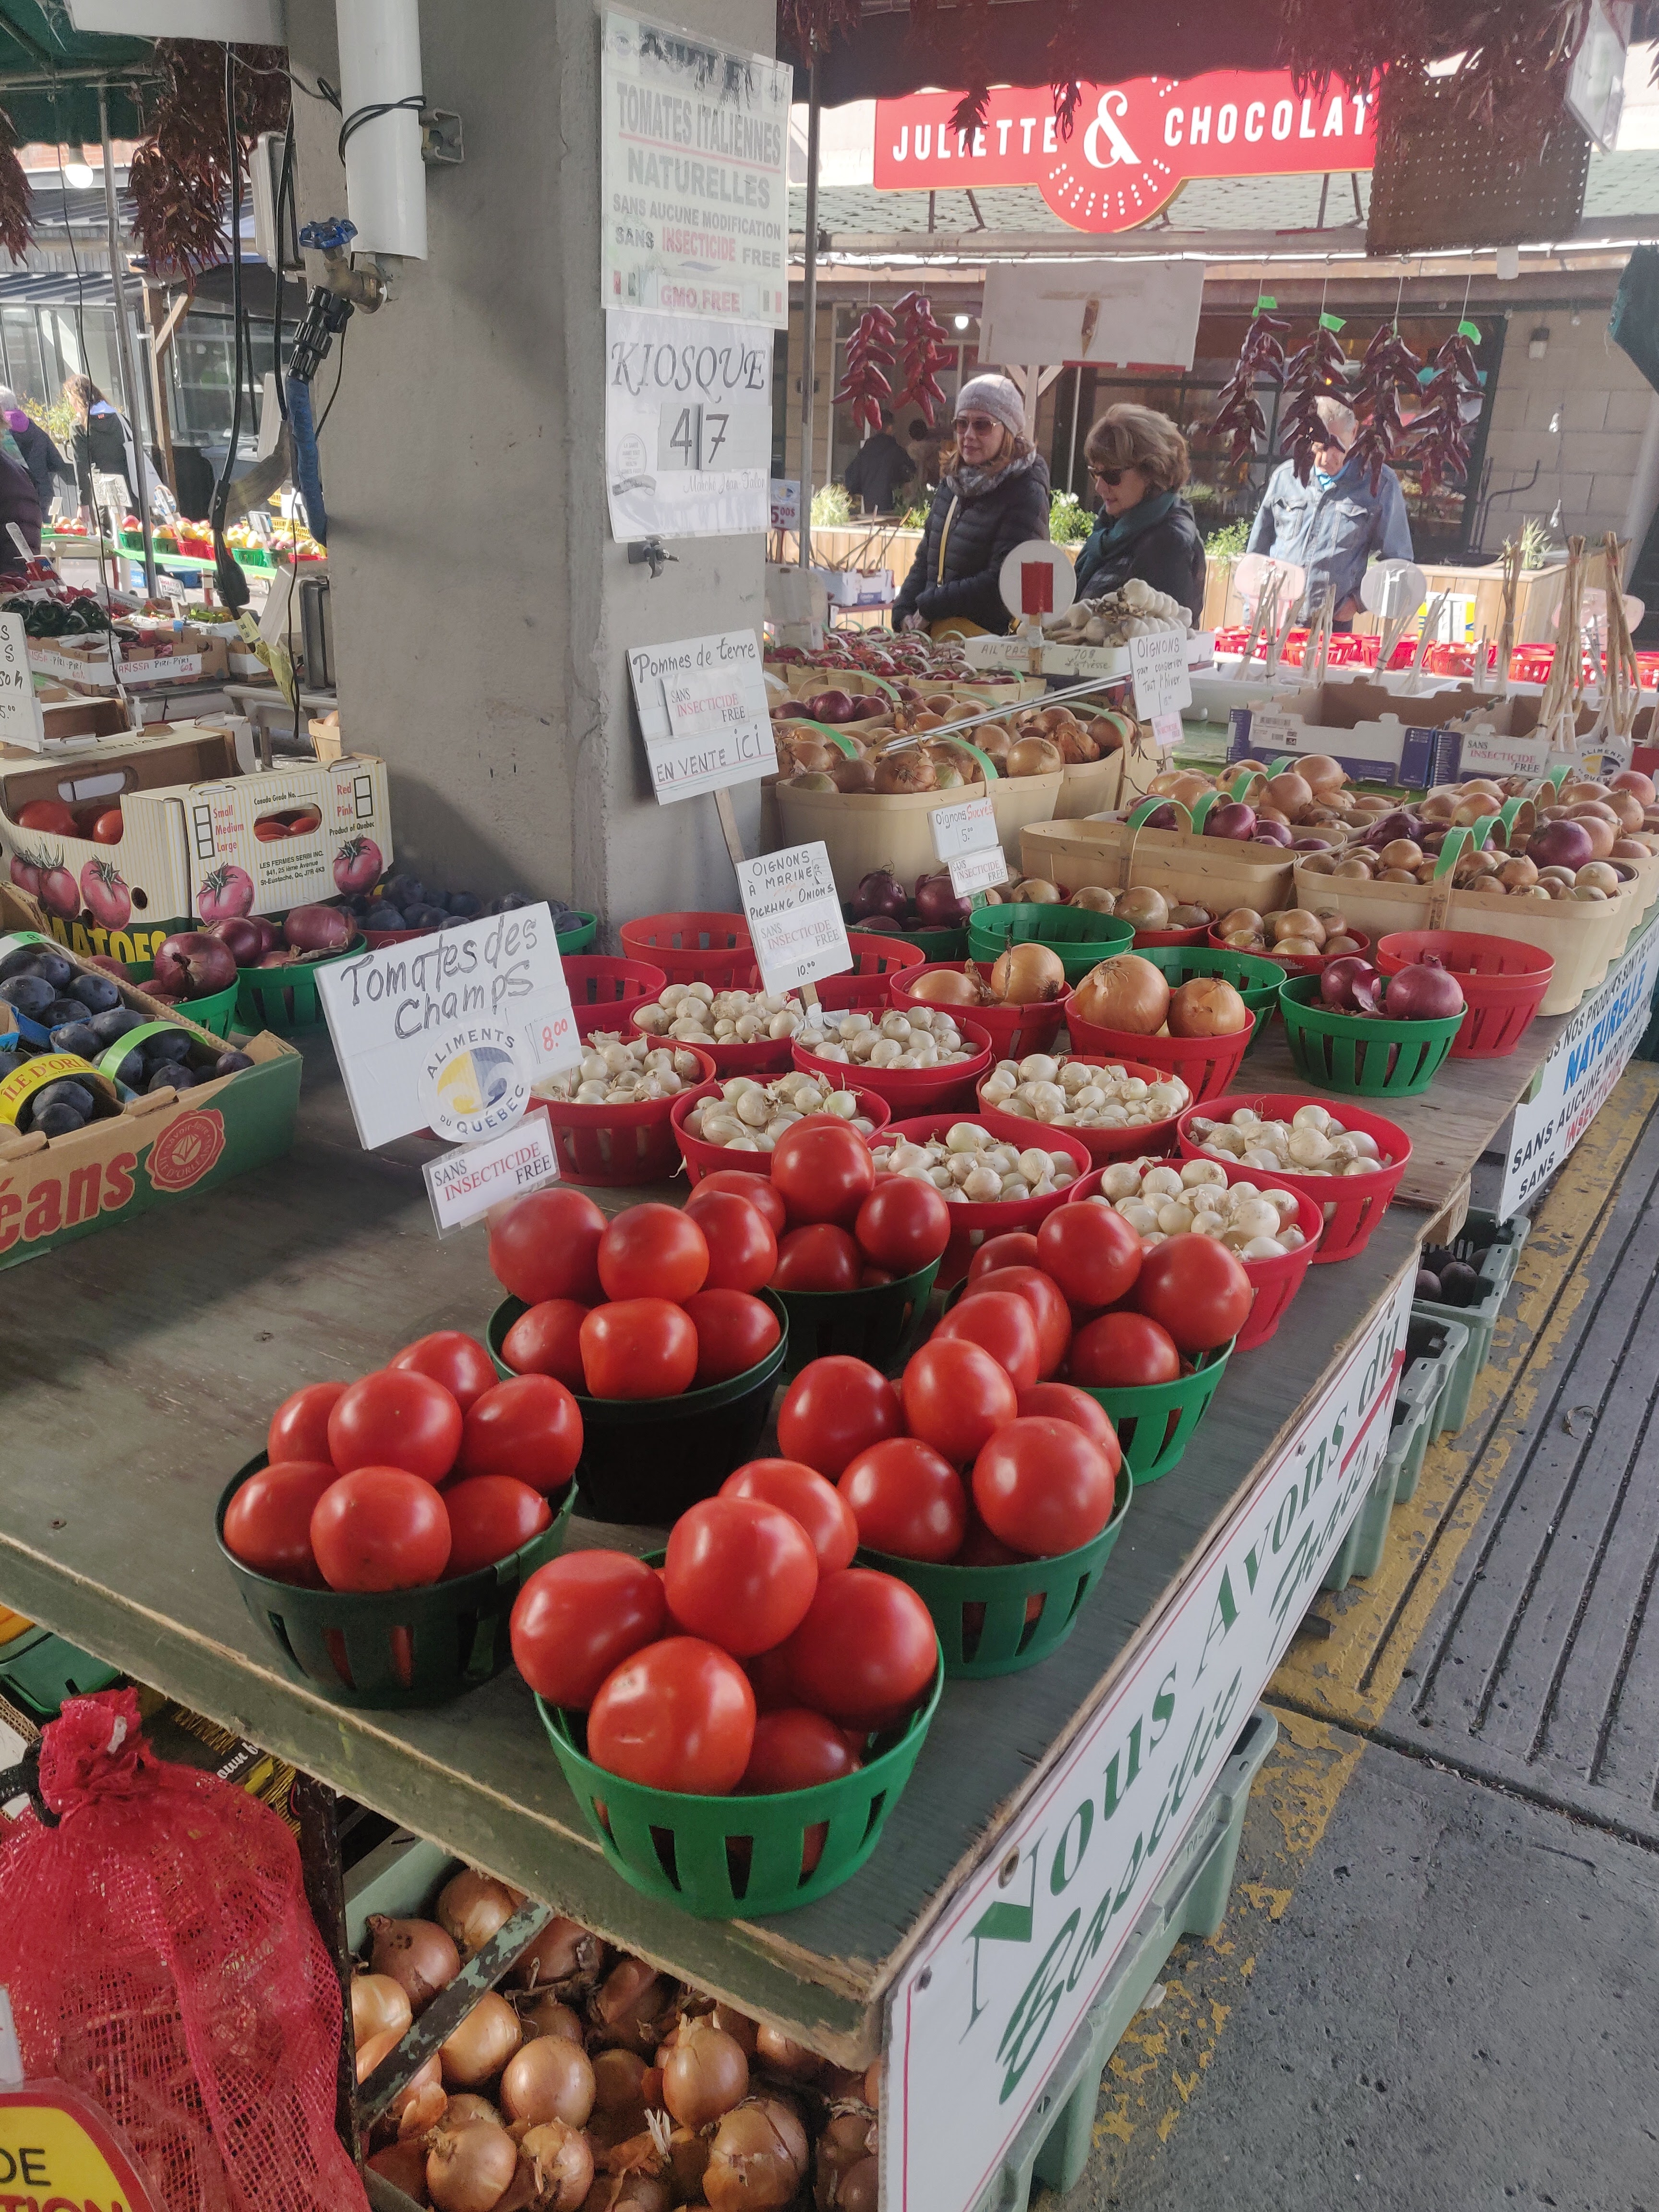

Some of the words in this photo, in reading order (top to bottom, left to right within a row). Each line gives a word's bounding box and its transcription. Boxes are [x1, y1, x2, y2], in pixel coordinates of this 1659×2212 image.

[617, 82, 692, 145] TOMATES
[697, 103, 781, 166] ITALIENNES
[1083, 90, 1142, 169] &
[1164, 93, 1373, 147] CHOCOLAT
[628, 147, 770, 209] NATURELLES
[613, 193, 646, 216] SANS
[650, 202, 699, 226] AUCUNE
[702, 211, 781, 240] MODIFICATION
[615, 227, 654, 249] SANS
[662, 227, 736, 261] INSECTICIDE
[742, 247, 781, 268] FREE
[661, 285, 697, 309] GMO
[703, 289, 740, 312] FREE
[611, 341, 767, 404] KIOSQUE
[684, 475, 716, 493] Marché
[633, 653, 691, 683] Pommes
[697, 643, 713, 666] de
[717, 637, 756, 660] terre
[1155, 659, 1182, 673] conserver
[672, 688, 691, 703] SANS
[677, 693, 739, 717] INSECTICIDE
[722, 706, 745, 722] FREE
[1467, 740, 1488, 750] SANS
[1470, 749, 1536, 764] INSECTICIDE
[656, 761, 674, 782] EN
[678, 748, 726, 776] VENTE
[1514, 763, 1540, 773] FREE
[254, 797, 271, 805] Canada
[272, 793, 287, 802] Grade
[337, 782, 352, 796] Red
[213, 805, 234, 819] Small
[337, 805, 353, 817] Pink
[936, 810, 966, 829] Oignons
[967, 800, 994, 820] Sucrés
[216, 822, 244, 836] Medium
[329, 827, 349, 837] Product
[349, 823, 355, 832] of
[962, 827, 973, 842] 5.00
[216, 842, 238, 853] Large
[272, 857, 295, 867] FERMES
[300, 860, 319, 869] Avenue
[752, 850, 810, 876] OIGNONS
[952, 860, 966, 871] SANS
[956, 860, 1000, 881] INSECTICIDE
[988, 868, 1005, 881] FREE
[747, 880, 756, 896] À
[749, 898, 793, 921] PICKLING
[798, 883, 834, 902] ONIONS
[761, 923, 782, 938] SANS
[768, 920, 831, 950] INSECTICIDE
[815, 929, 840, 947] FREE
[340, 933, 478, 1006] Tomates
[484, 915, 538, 968] des
[797, 961, 816, 977] 10.00
[1563, 1011, 1585, 1050] NOS
[1585, 970, 1623, 1029] PRODUITS
[541, 1018, 569, 1052] 8.00
[426, 1028, 515, 1080] ALIMENTS
[0, 1074, 32, 1102] ÎLE
[440, 1114, 453, 1128] DU
[457, 1084, 525, 1135] QUÉBEC
[1512, 1119, 1553, 1174] SANS
[1556, 1064, 1602, 1134] AUCUNE
[433, 1159, 468, 1188] SANS
[444, 1142, 541, 1202] INSECTICIDE
[516, 1154, 553, 1185] FREE
[1519, 1151, 1555, 1200] SANS
[959, 1662, 1177, 2044] Nous
[1192, 1400, 1348, 1688] Avons
[1358, 1313, 1401, 1418] du
[996, 1666, 1242, 2105] Basilic
